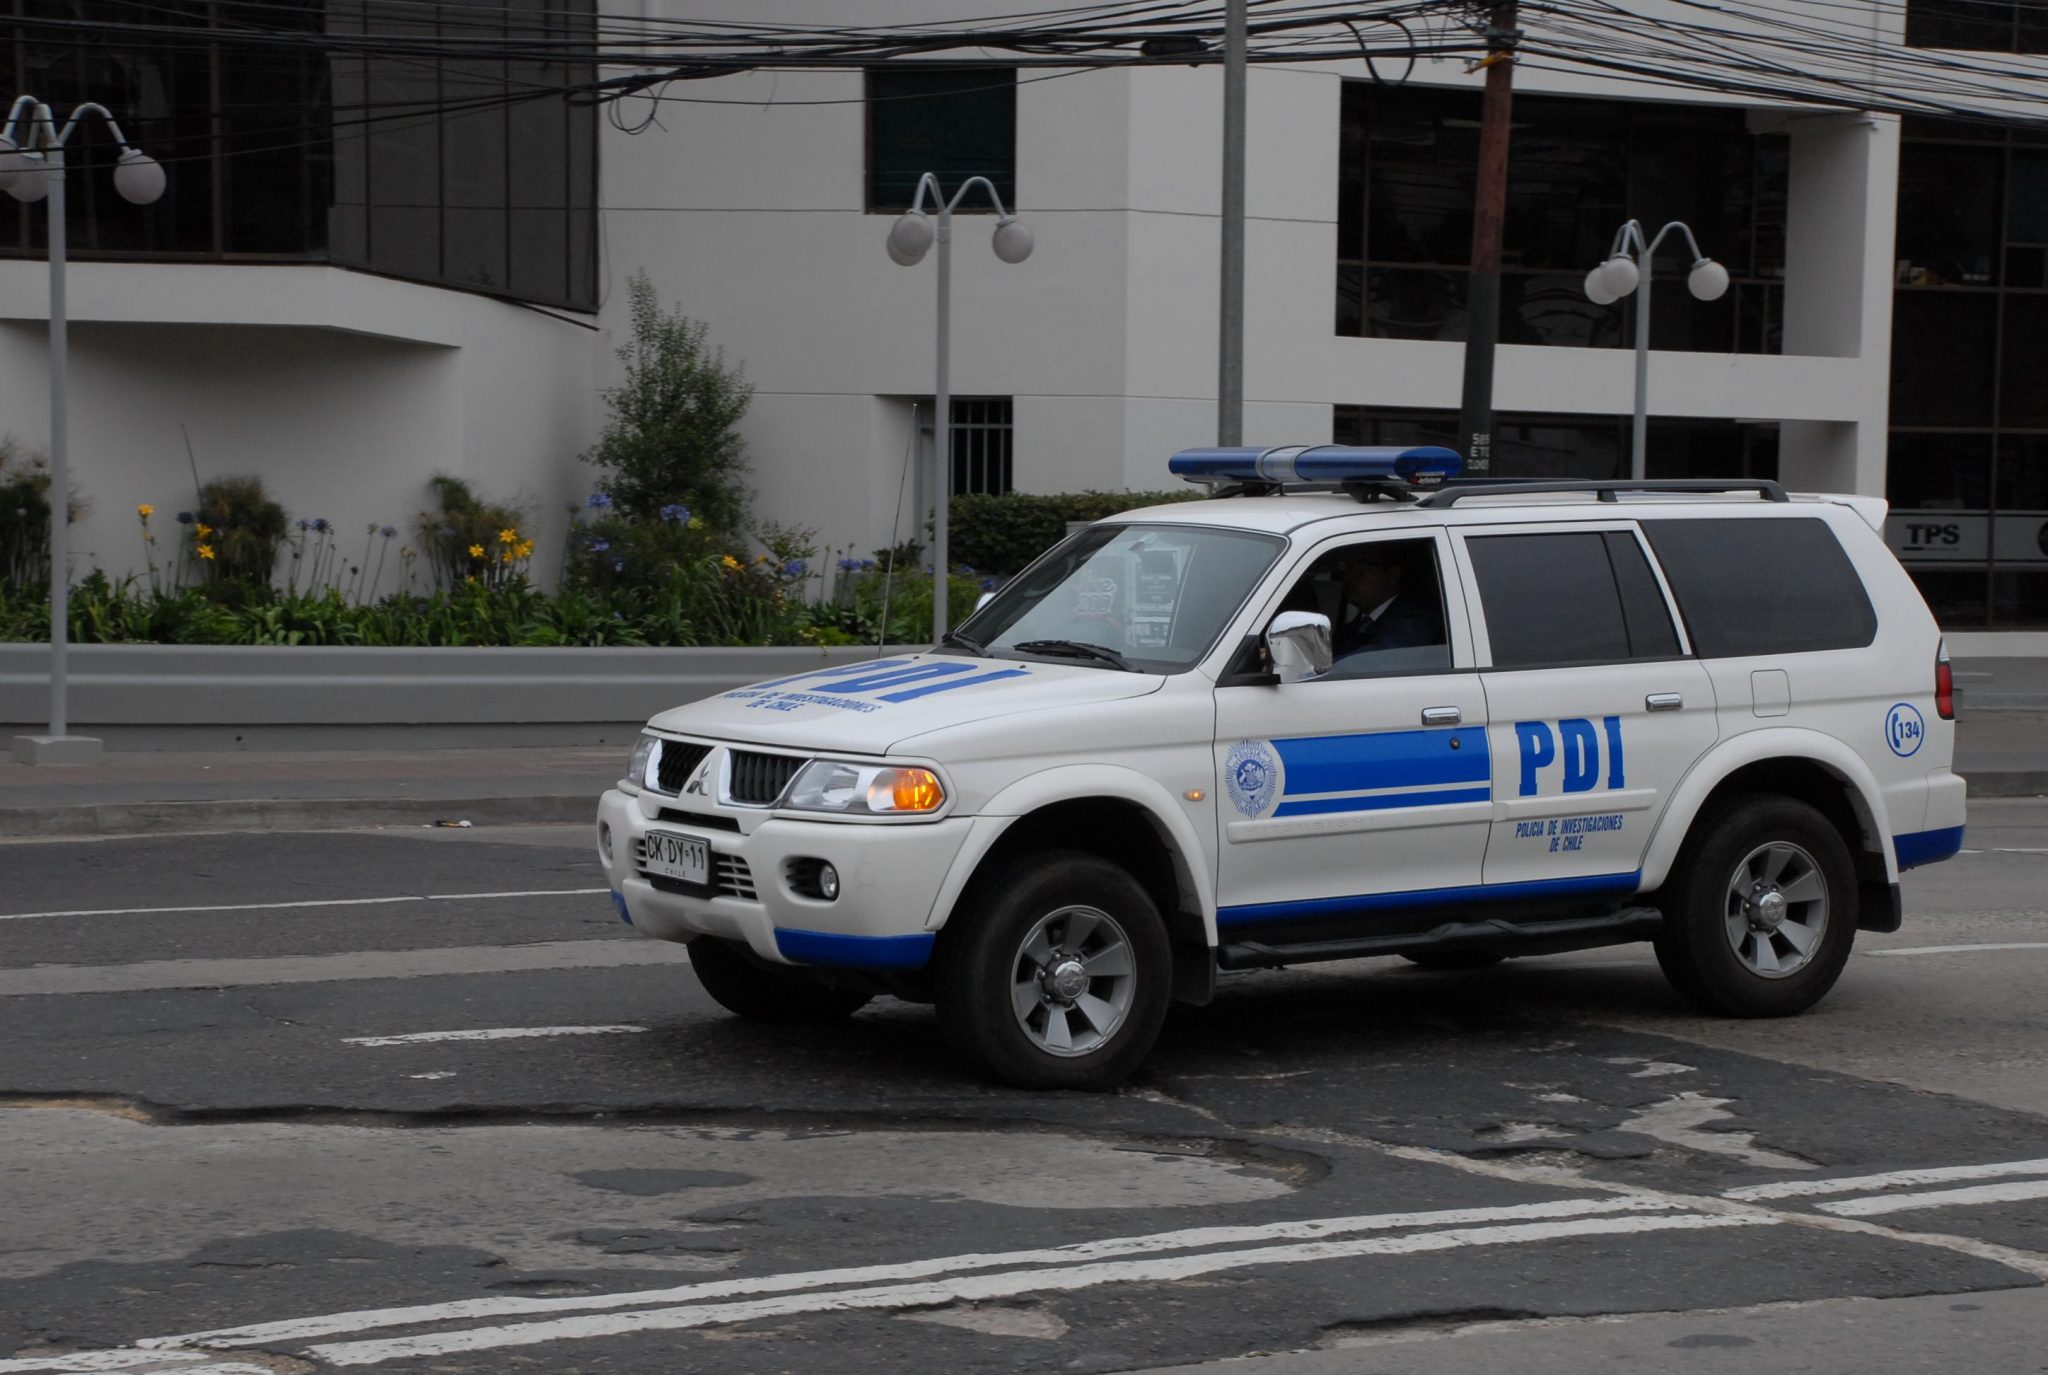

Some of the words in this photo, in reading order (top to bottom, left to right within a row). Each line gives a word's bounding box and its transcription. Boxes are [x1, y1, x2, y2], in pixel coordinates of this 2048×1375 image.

[1905, 523, 1961, 544] TPS
[748, 660, 1032, 703] PDI
[1898, 721, 1920, 739] 134
[1515, 716, 1625, 796] PDI
[1515, 821, 1544, 838] POLICIA
[1547, 819, 1558, 835] DE
[1560, 814, 1623, 834] INVESTIGACIONES
[1549, 837, 1560, 853] DE
[1562, 835, 1584, 851] CHILE
[665, 868, 688, 878] CHILE
